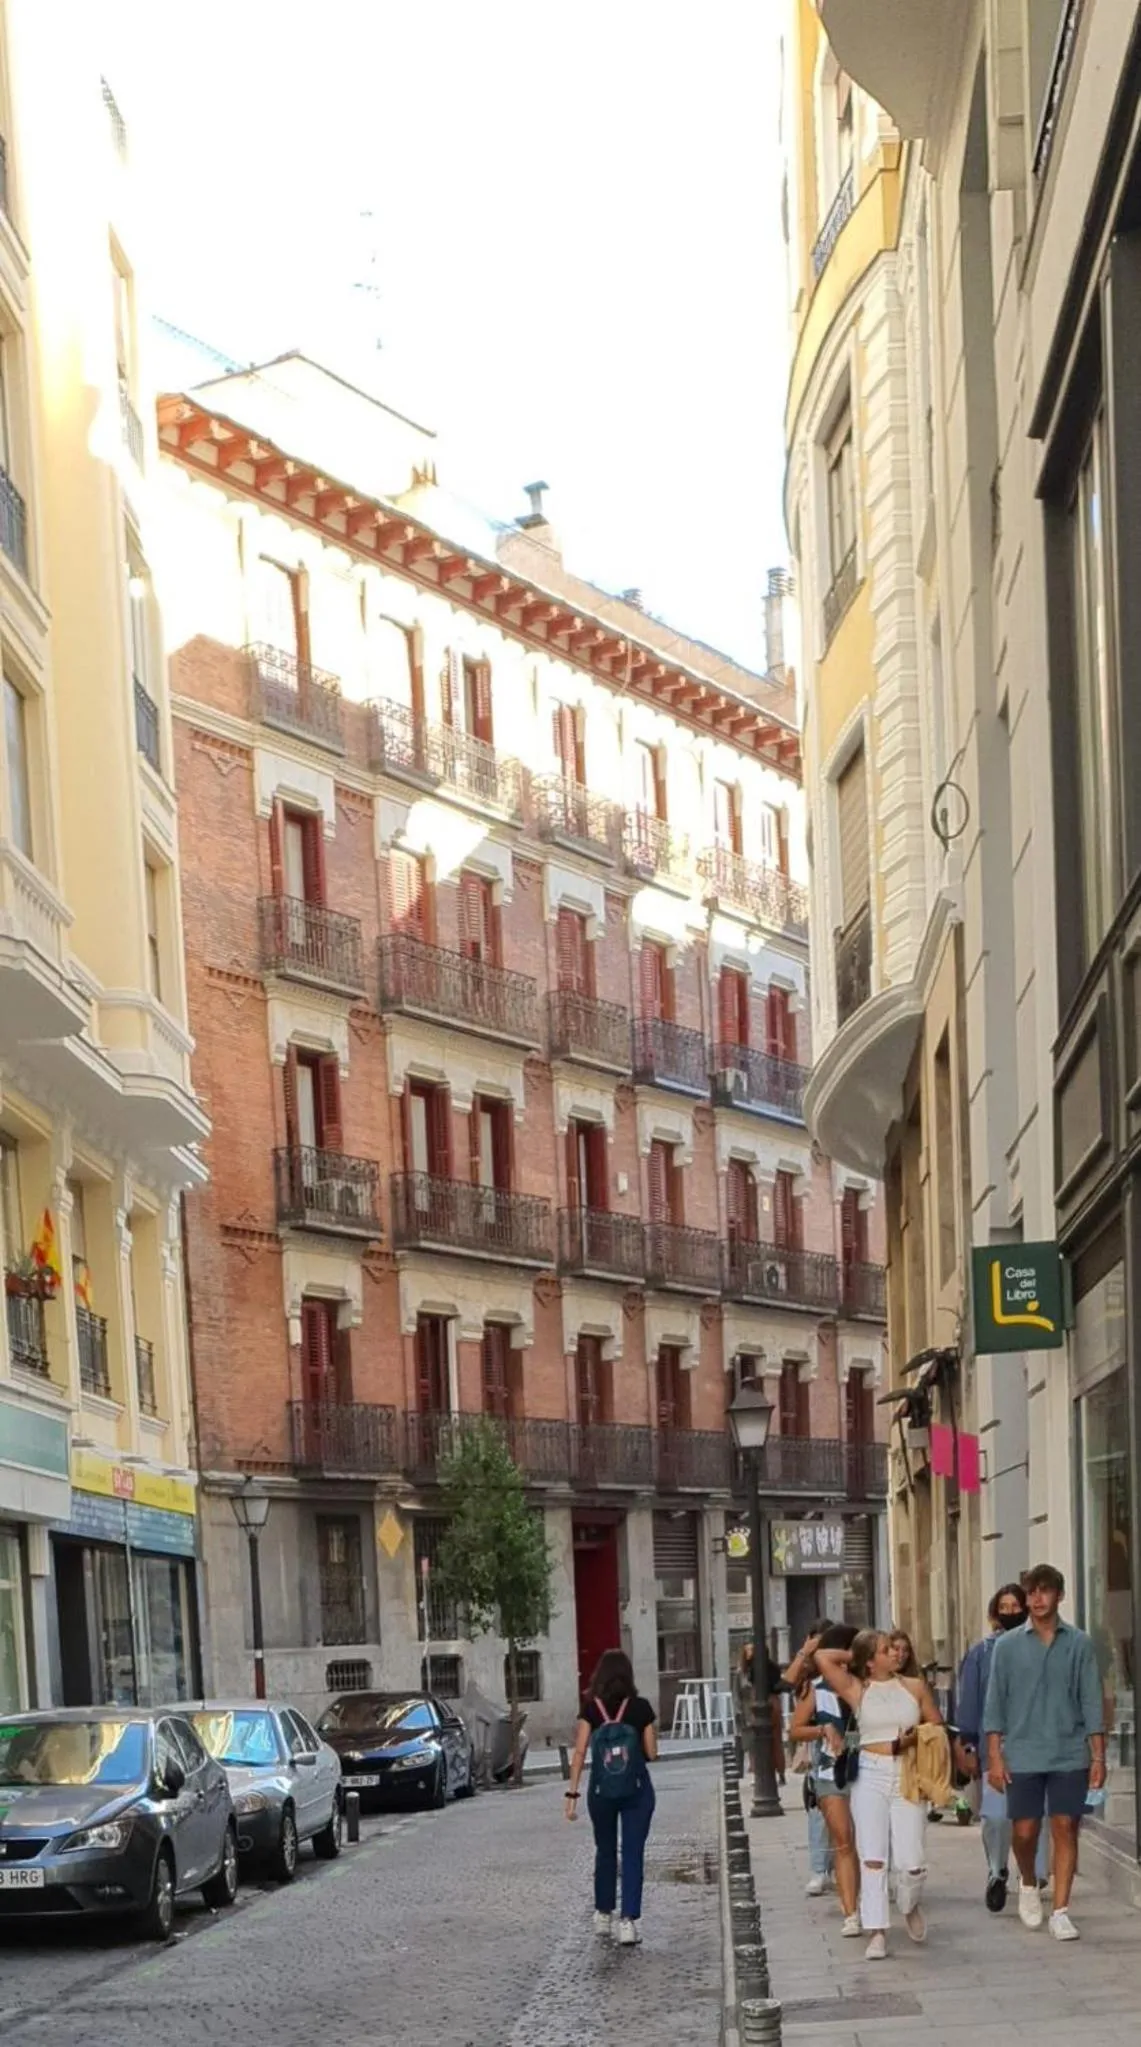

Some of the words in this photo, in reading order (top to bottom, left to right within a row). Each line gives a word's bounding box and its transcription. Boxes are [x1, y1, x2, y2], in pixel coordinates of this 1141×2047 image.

[1005, 1267, 1036, 1279] Casa
[1019, 1279, 1036, 1289] del
[1006, 1289, 1036, 1301] Libro
[10, 1870, 39, 1884] HRG
